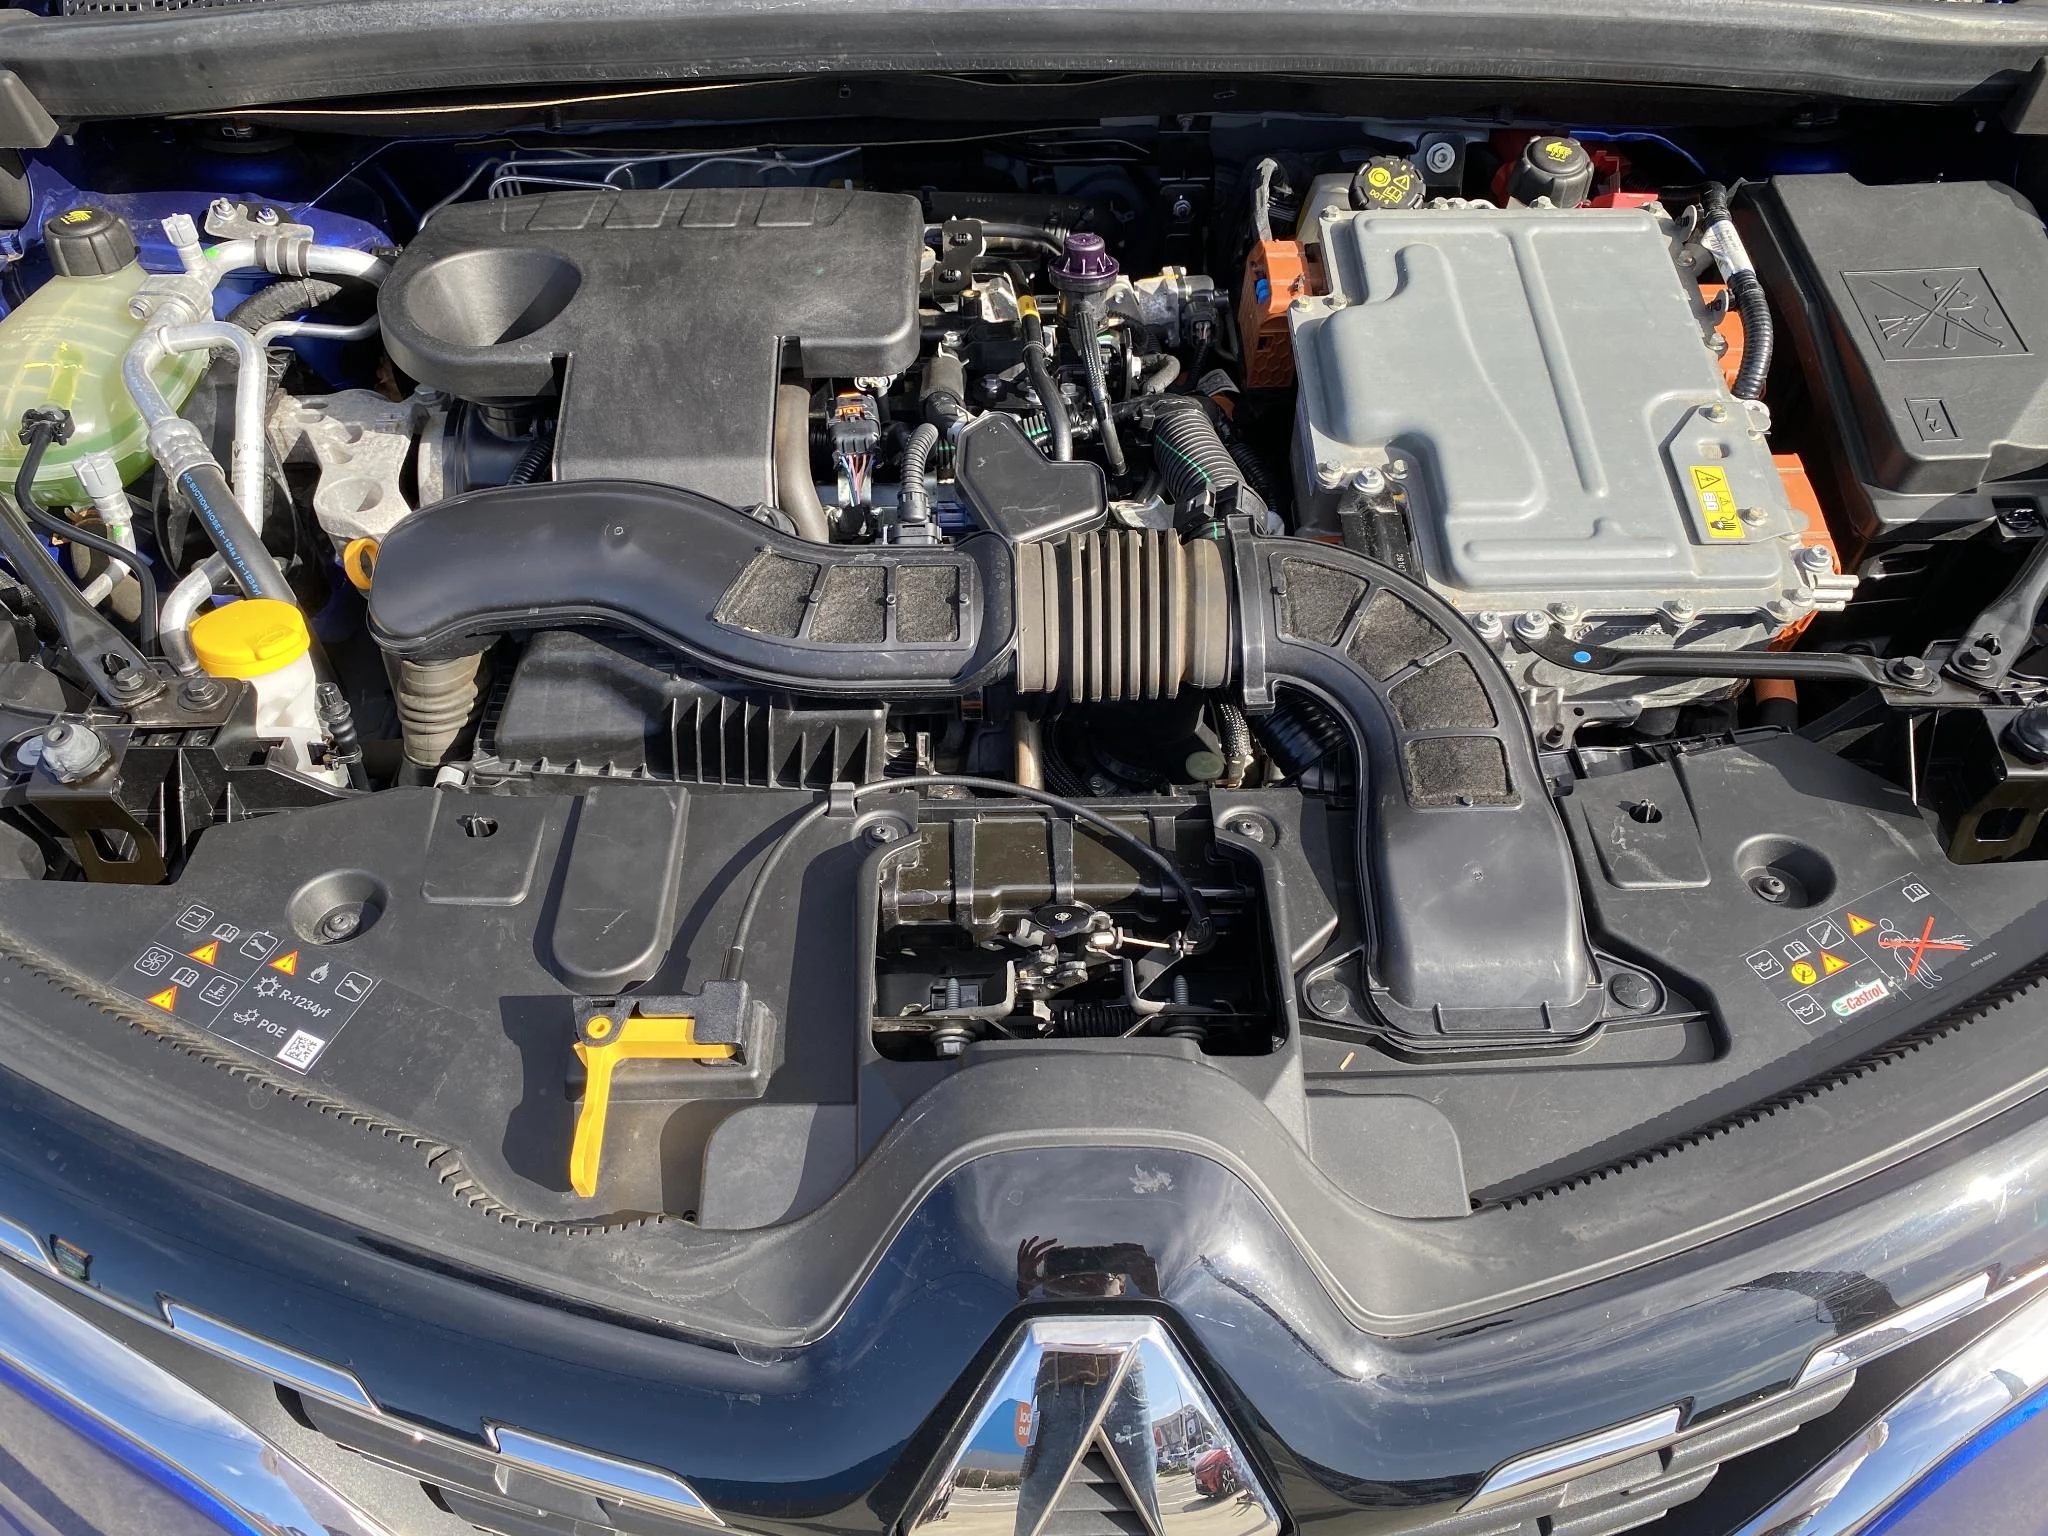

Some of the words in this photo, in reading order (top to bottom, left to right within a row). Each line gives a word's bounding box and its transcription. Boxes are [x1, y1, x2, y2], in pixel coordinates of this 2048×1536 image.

[1369, 189, 1384, 201] DOT
[189, 482, 209, 511] SUCTION
[206, 508, 222, 531] HOSE
[218, 529, 236, 557] R-134a
[237, 560, 263, 596] R-1234yf
[278, 989, 332, 1019] R-1234yf
[1846, 983, 1885, 1011] Castrol
[257, 1018, 288, 1039] POE
